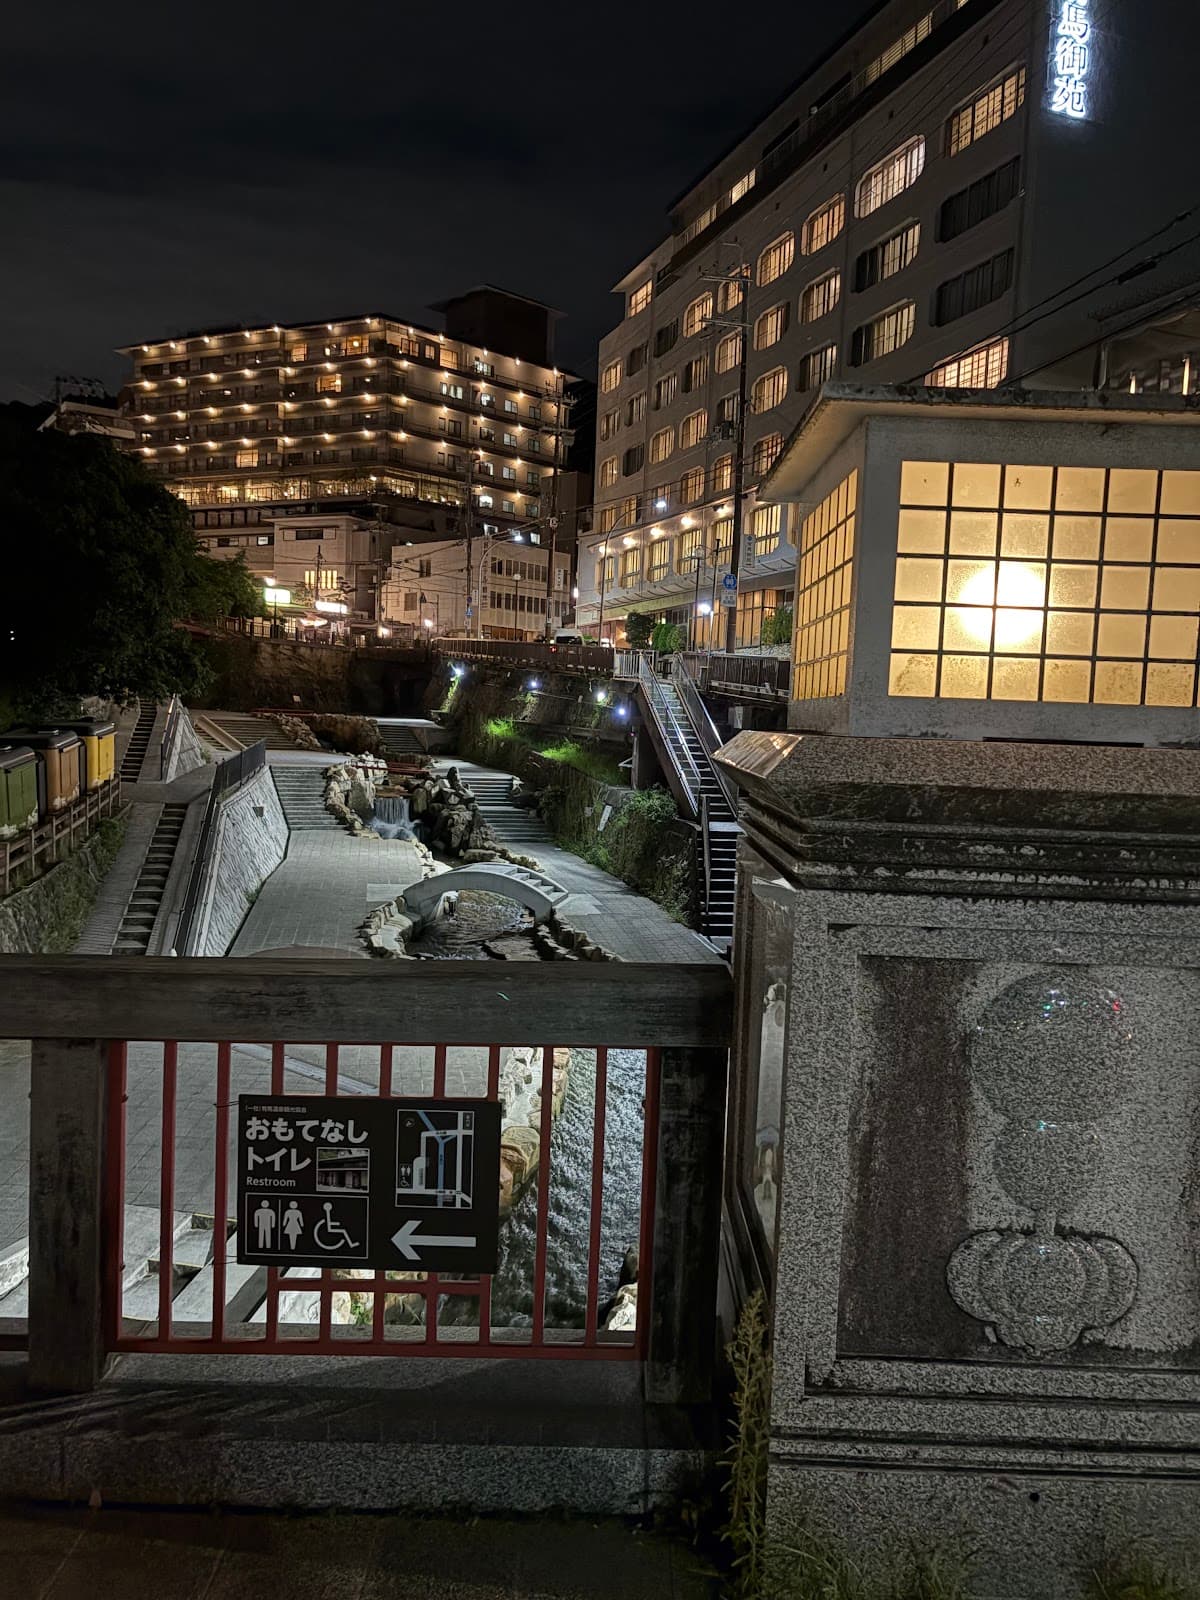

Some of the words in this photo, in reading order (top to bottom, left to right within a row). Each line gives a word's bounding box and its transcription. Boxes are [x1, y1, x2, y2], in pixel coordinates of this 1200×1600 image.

[1052, 0, 1089, 117] 馬御苑
[245, 1116, 369, 1144] おもてなし
[247, 1146, 312, 1172] トイレ
[246, 1176, 296, 1187] Restroom
